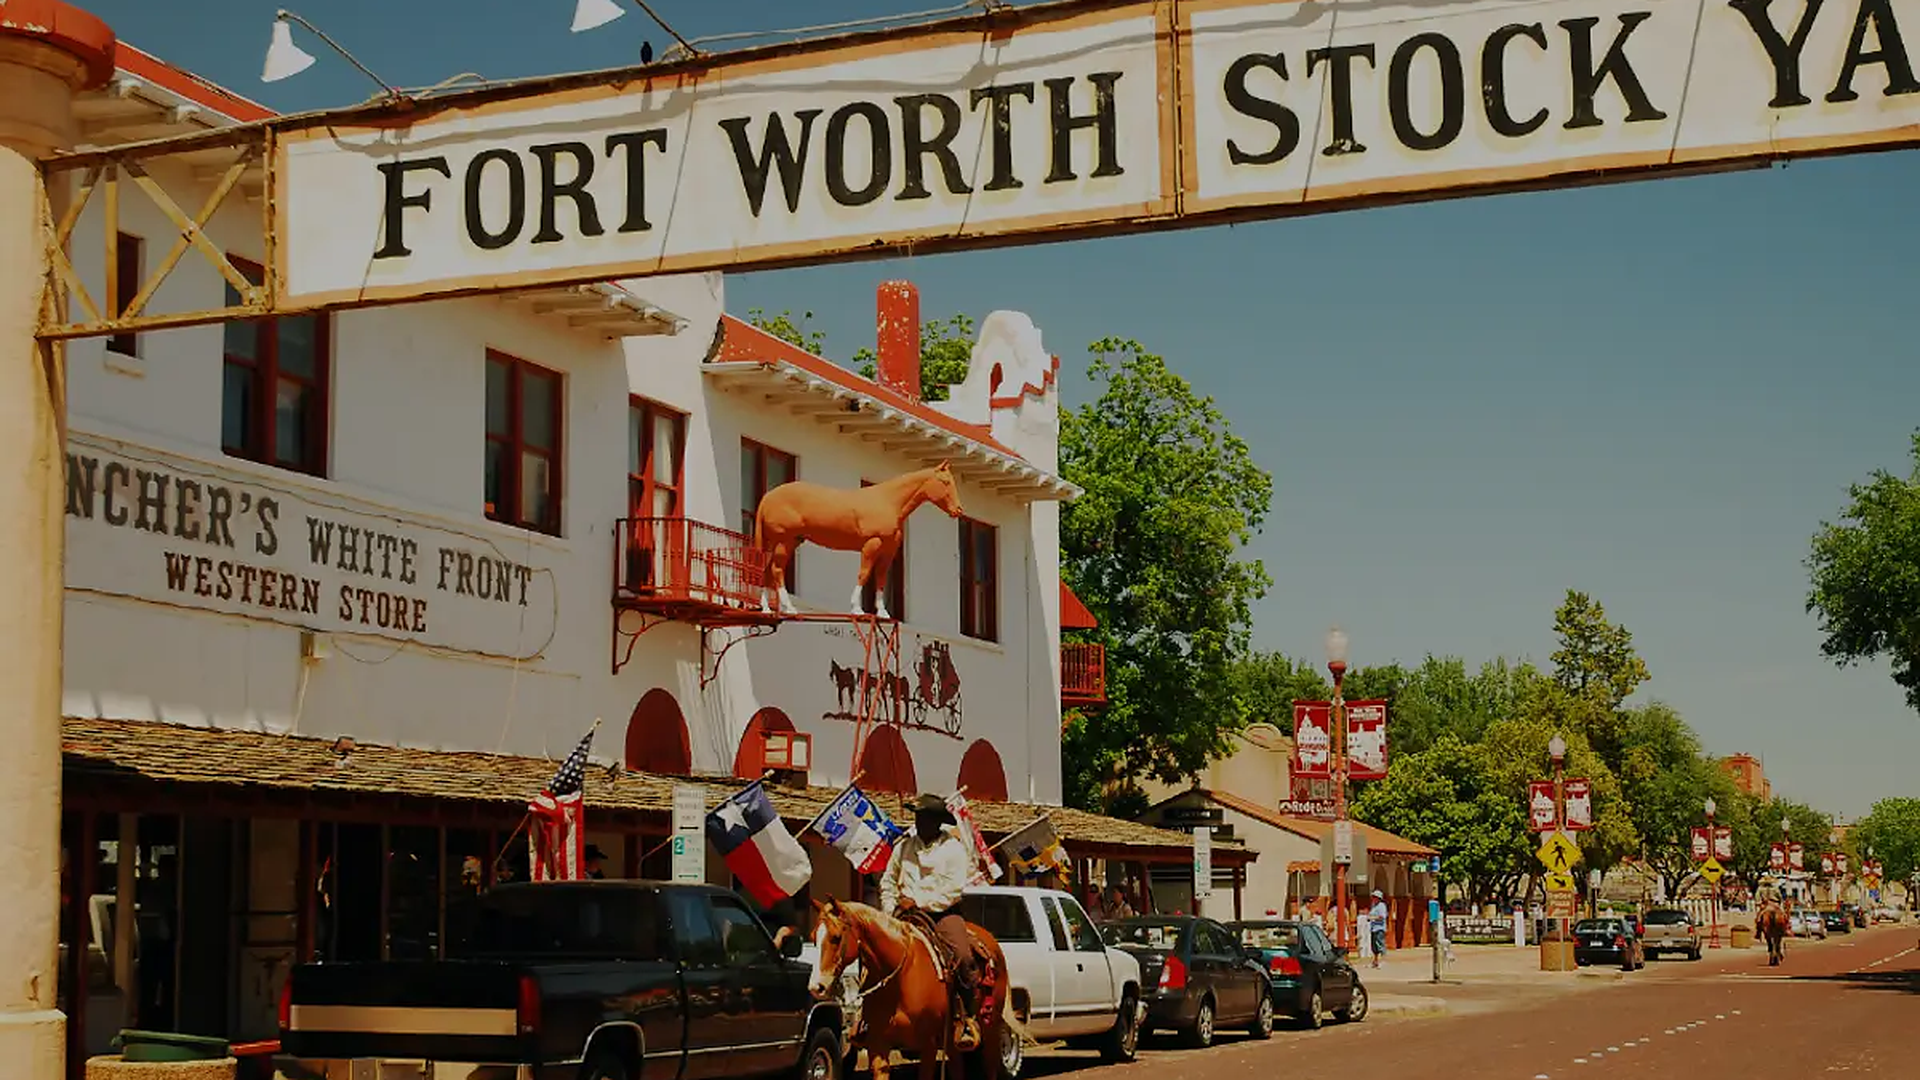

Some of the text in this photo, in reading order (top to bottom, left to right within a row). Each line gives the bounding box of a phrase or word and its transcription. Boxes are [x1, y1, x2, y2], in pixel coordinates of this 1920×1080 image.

[373, 128, 669, 260] FORT
[718, 71, 1126, 218] WORTH
[1222, 11, 1668, 166] STOCK
[164, 551, 428, 633] WESTERN STORE
[306, 515, 418, 584] WHITE
[436, 547, 532, 607] FRONT
